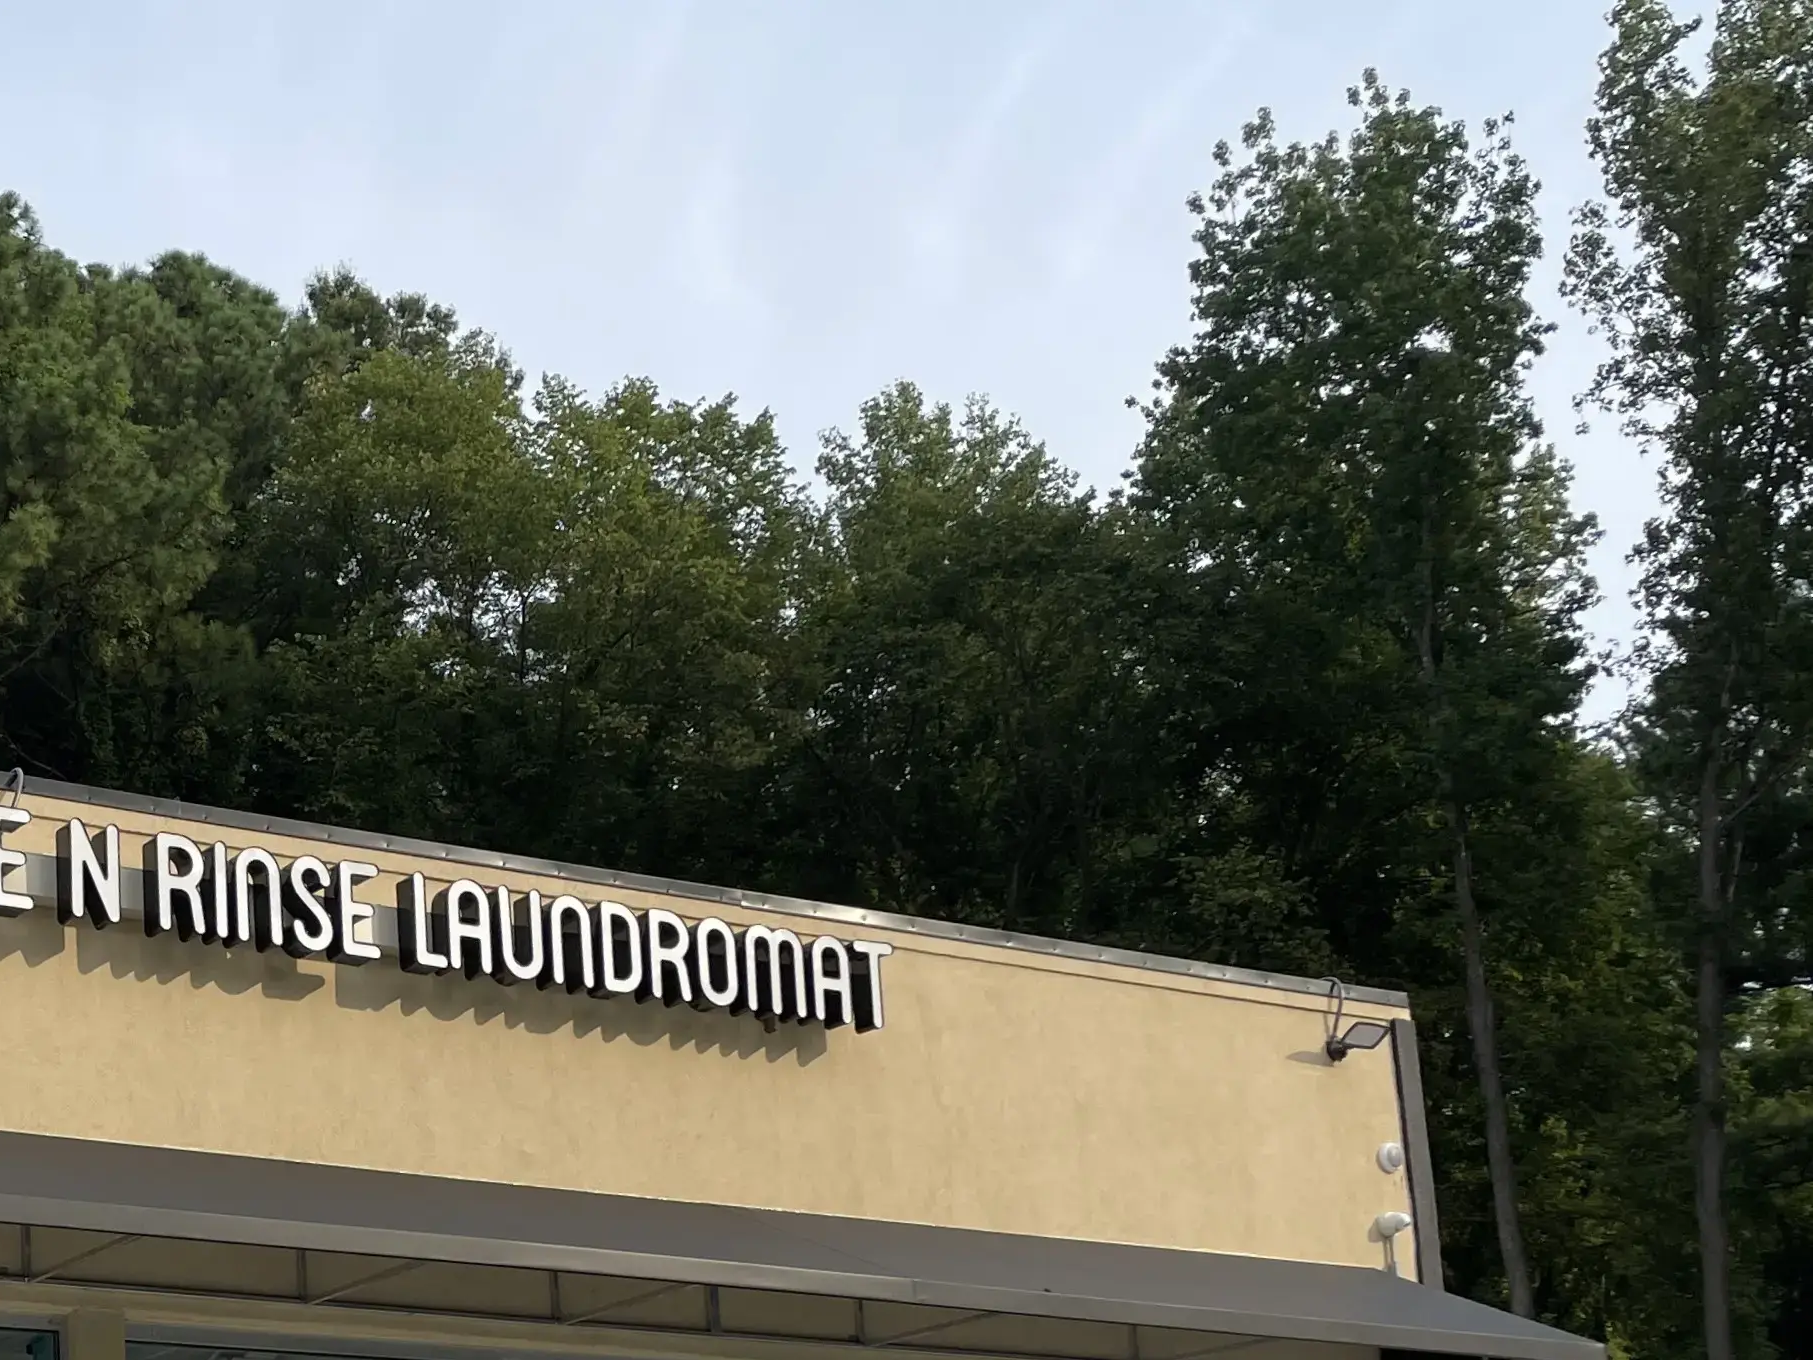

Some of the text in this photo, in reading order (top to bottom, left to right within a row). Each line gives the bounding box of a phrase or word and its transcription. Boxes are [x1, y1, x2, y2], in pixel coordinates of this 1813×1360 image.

[68, 817, 121, 924] N
[154, 831, 382, 961] RINSE
[411, 871, 893, 1030] LAUNDROMAT
